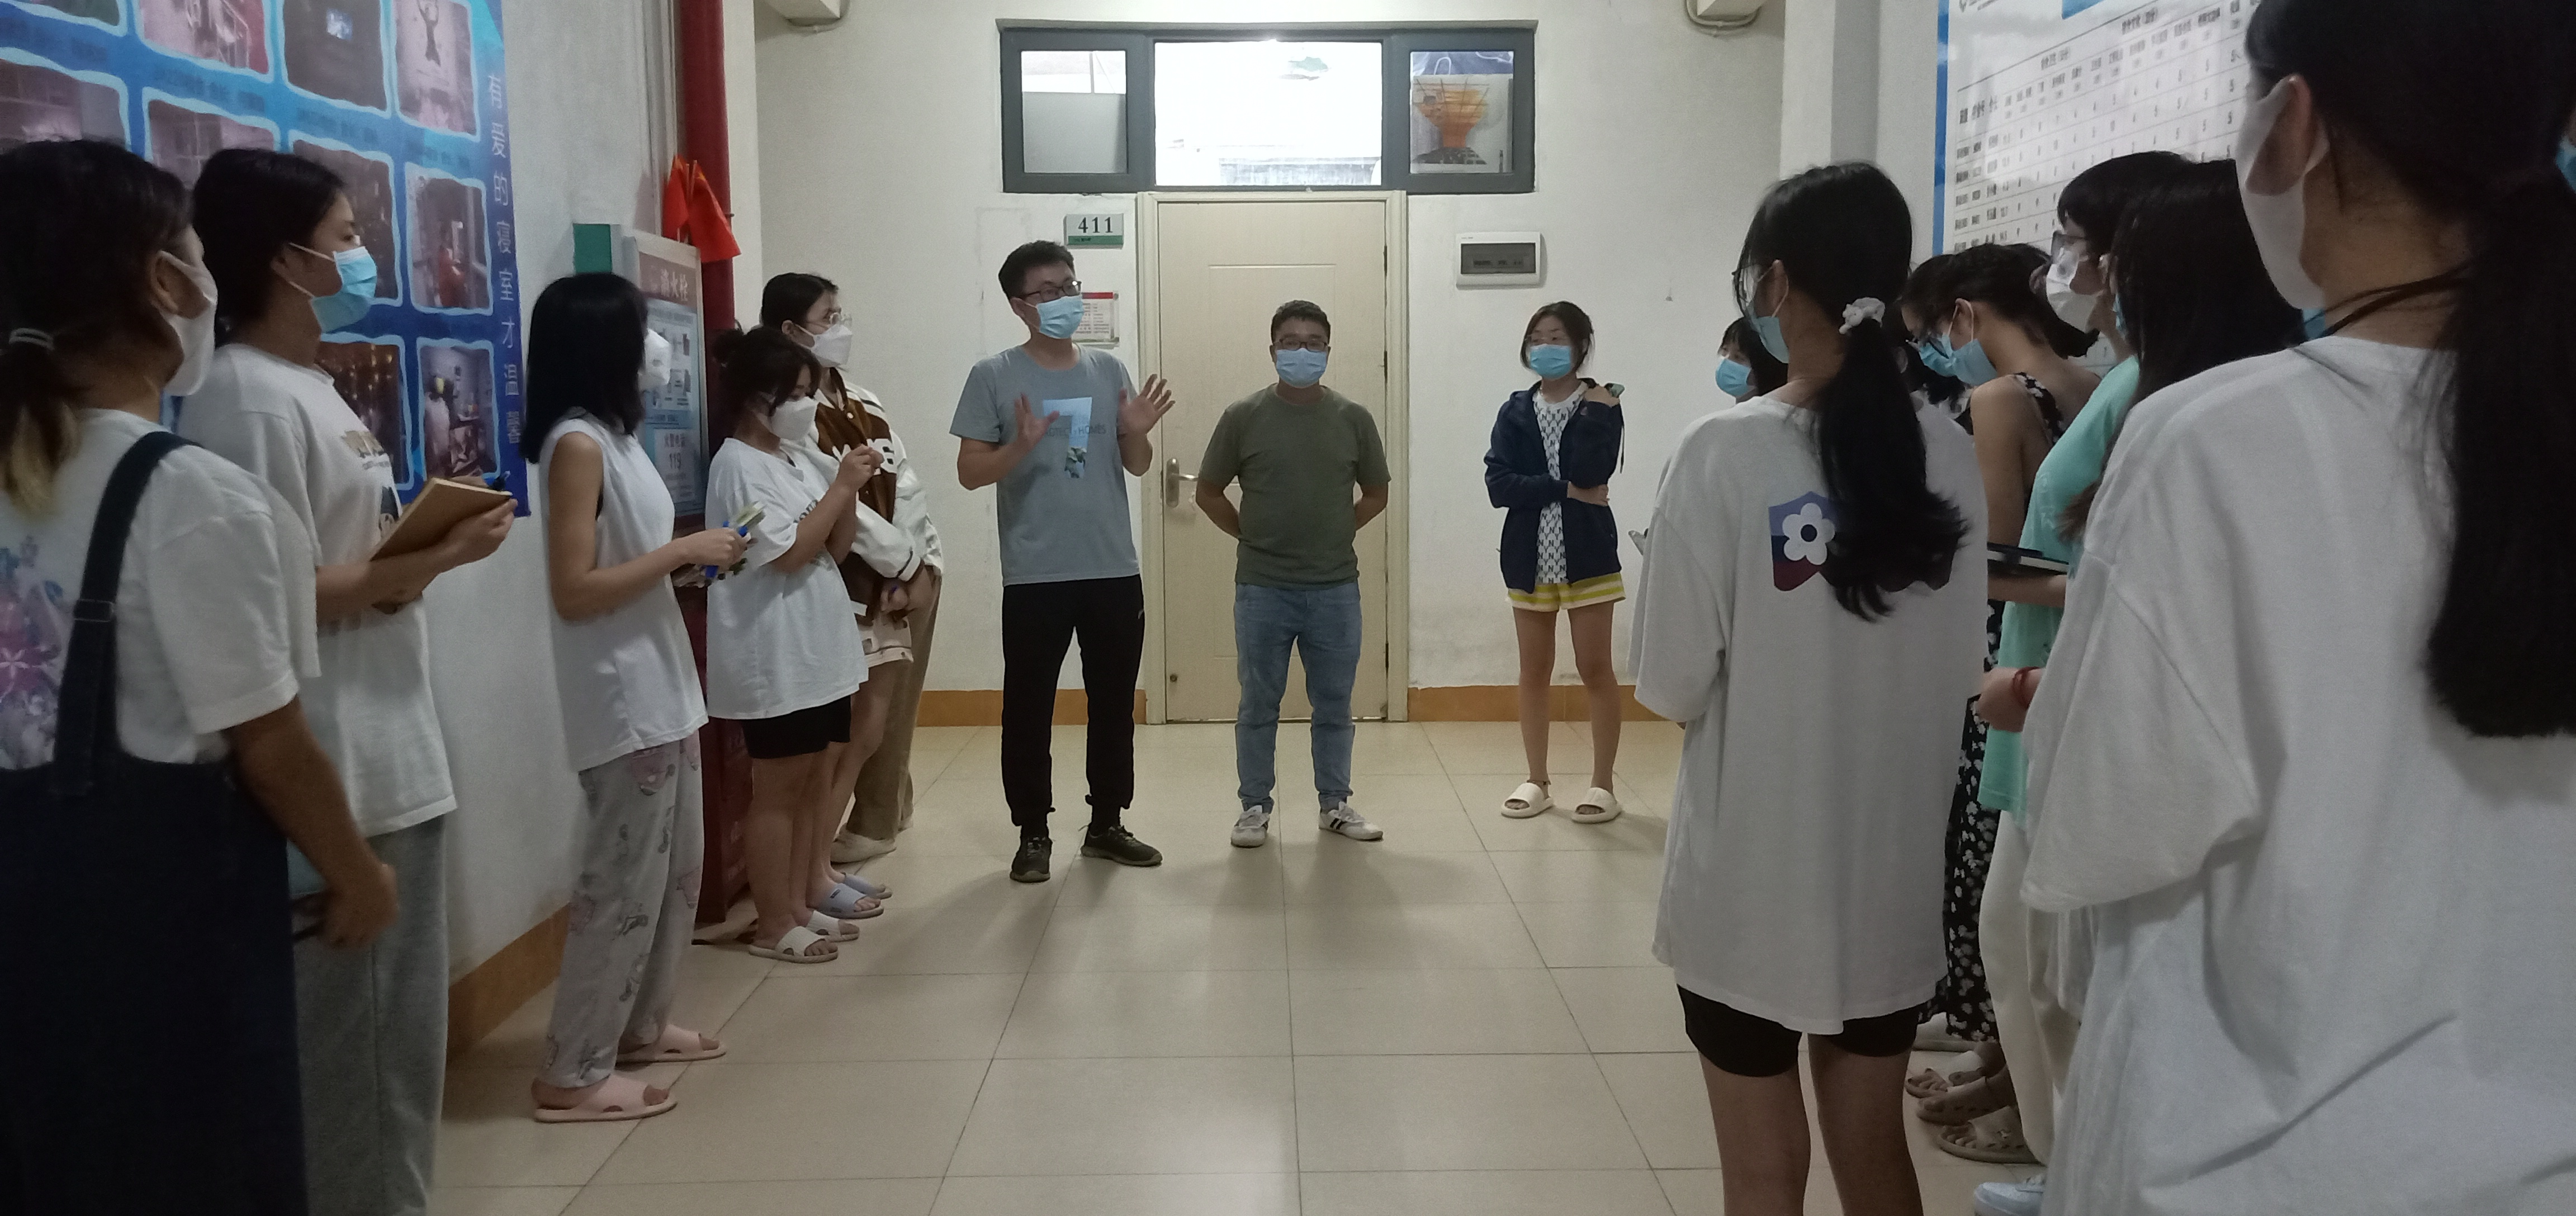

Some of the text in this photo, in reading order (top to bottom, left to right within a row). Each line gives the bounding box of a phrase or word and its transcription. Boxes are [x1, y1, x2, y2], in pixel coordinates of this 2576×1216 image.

[1078, 216, 1113, 234] 411
[661, 268, 688, 302] 消火栓
[669, 452, 681, 469] 119
